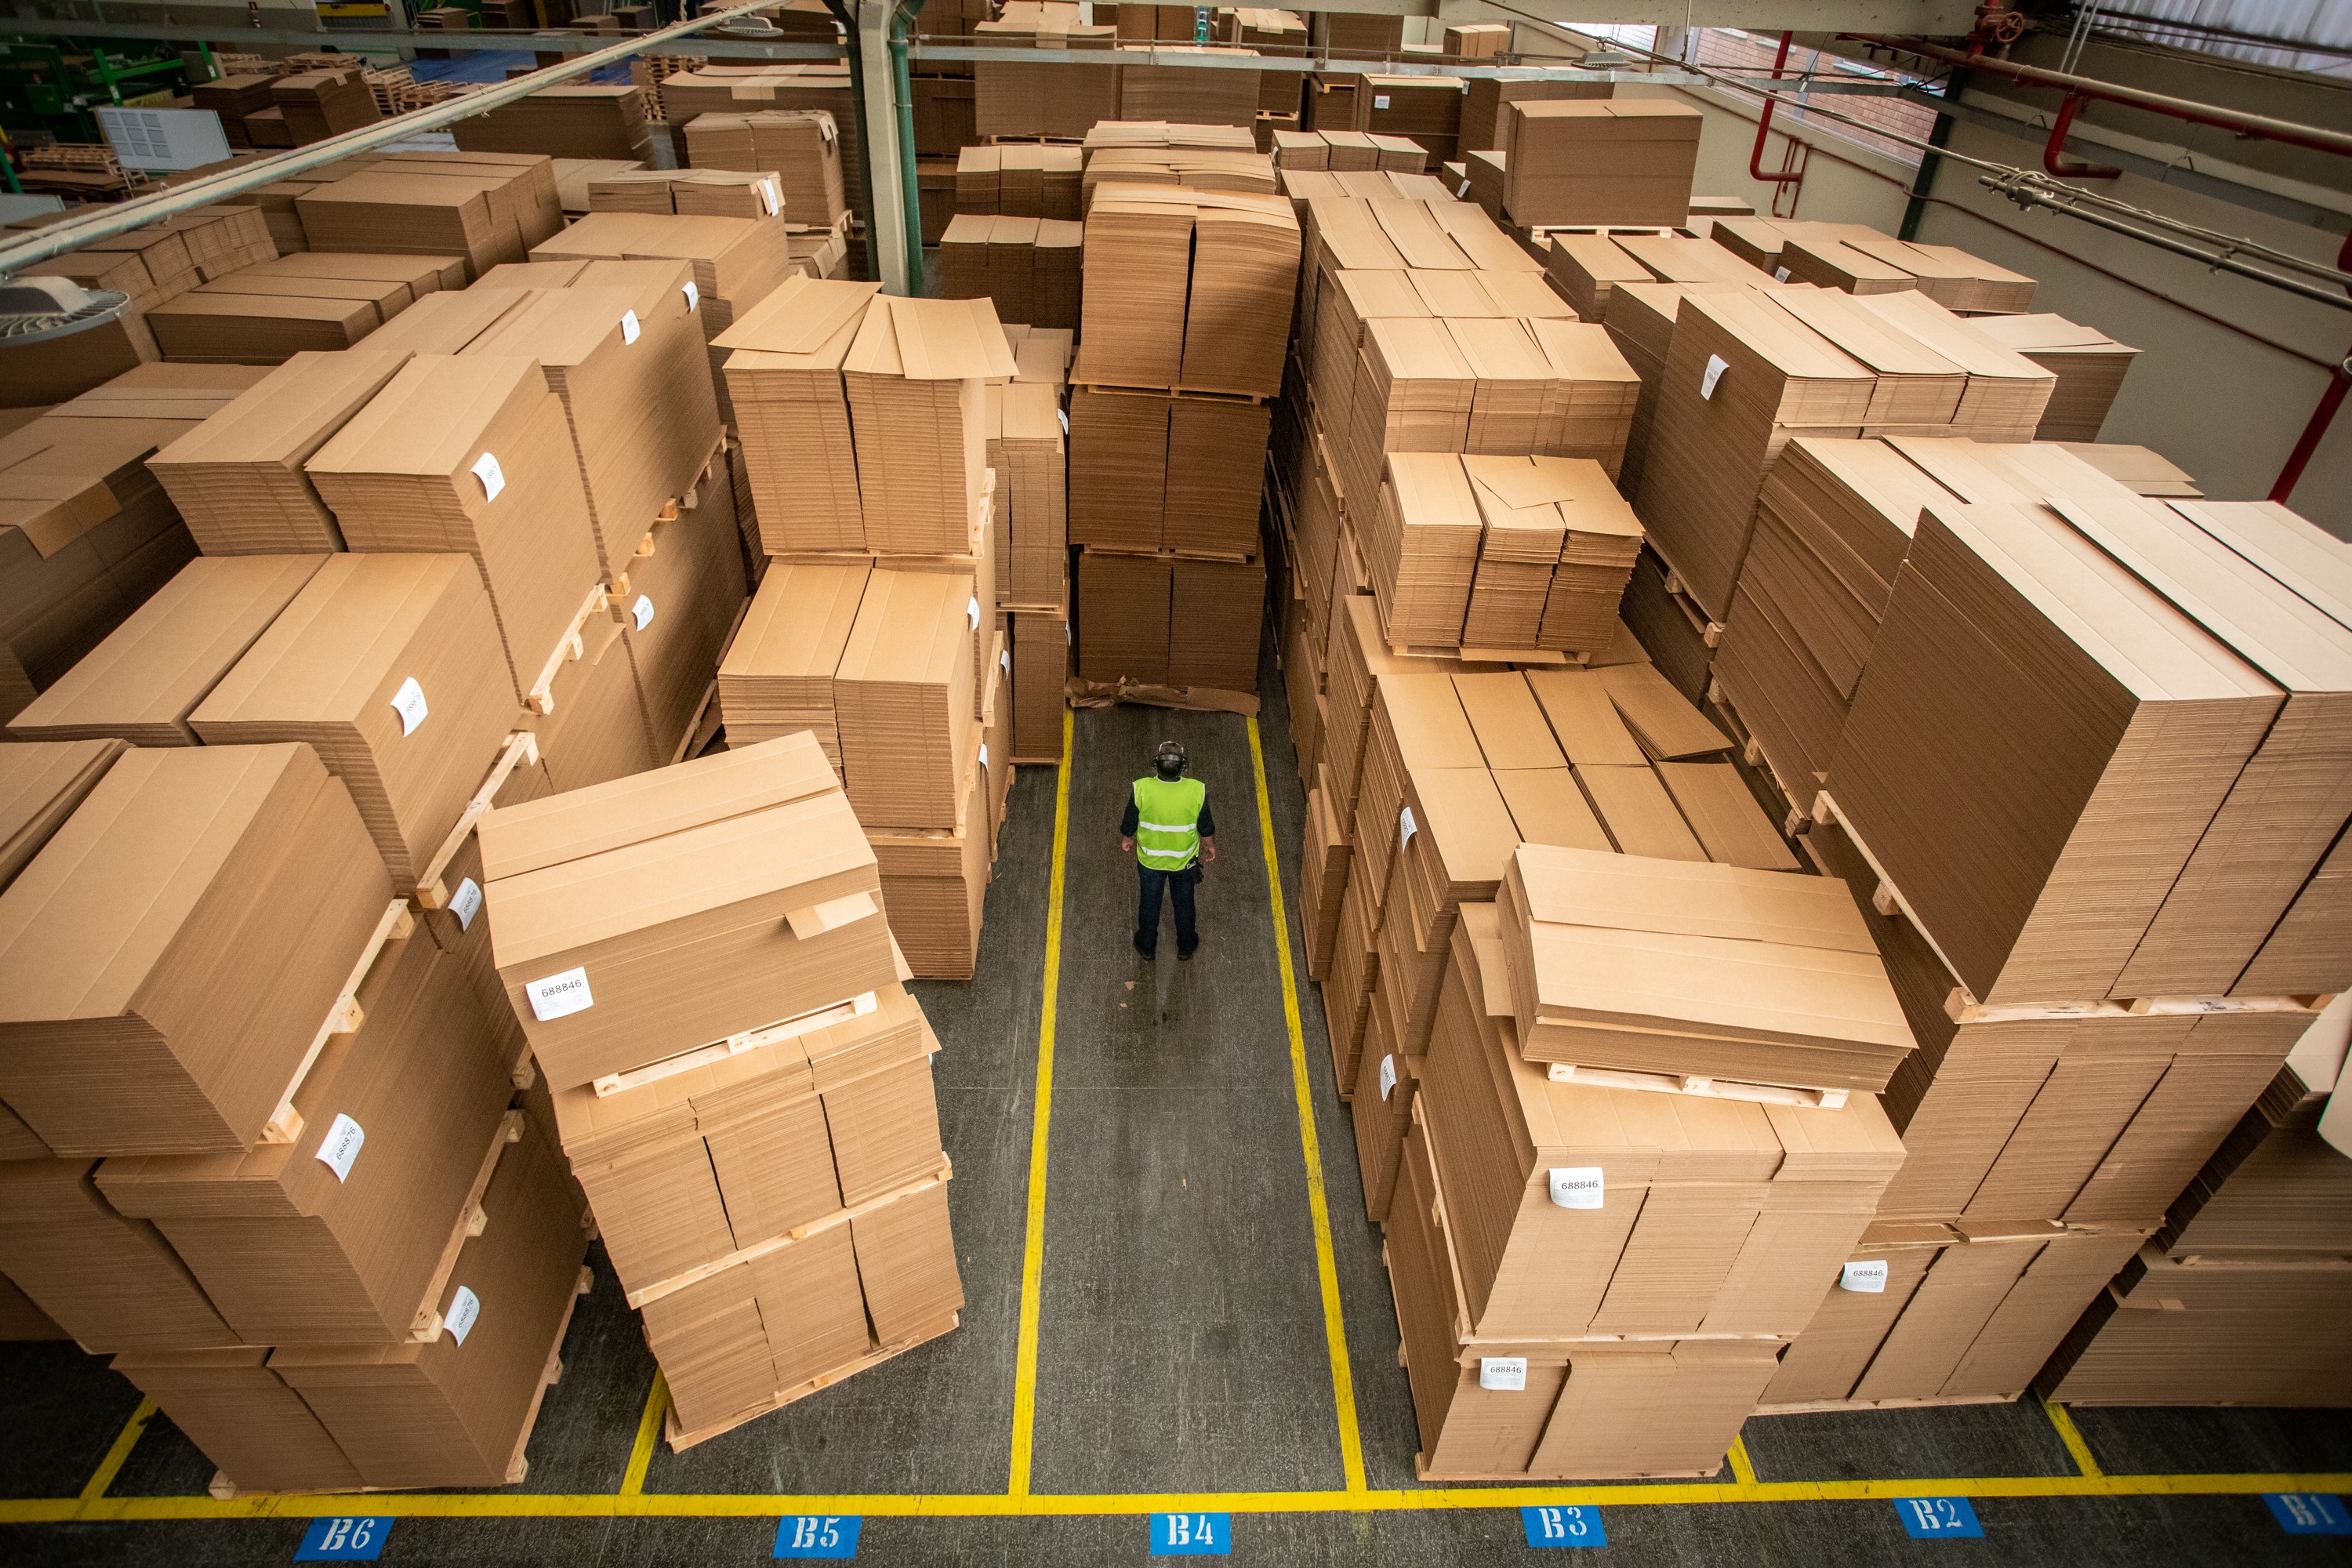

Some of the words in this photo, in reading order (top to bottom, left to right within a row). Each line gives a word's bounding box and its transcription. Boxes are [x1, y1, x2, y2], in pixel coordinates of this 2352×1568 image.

[542, 979, 582, 997] 688846
[336, 1127, 356, 1160] 688876
[1561, 1180, 1599, 1190] 688846
[1538, 1506, 1588, 1538] B3
[1908, 1498, 1963, 1530] B2
[2279, 1494, 2335, 1525] B1
[318, 1518, 376, 1550] B6
[791, 1517, 840, 1548] B5
[1167, 1515, 1213, 1545] B4
